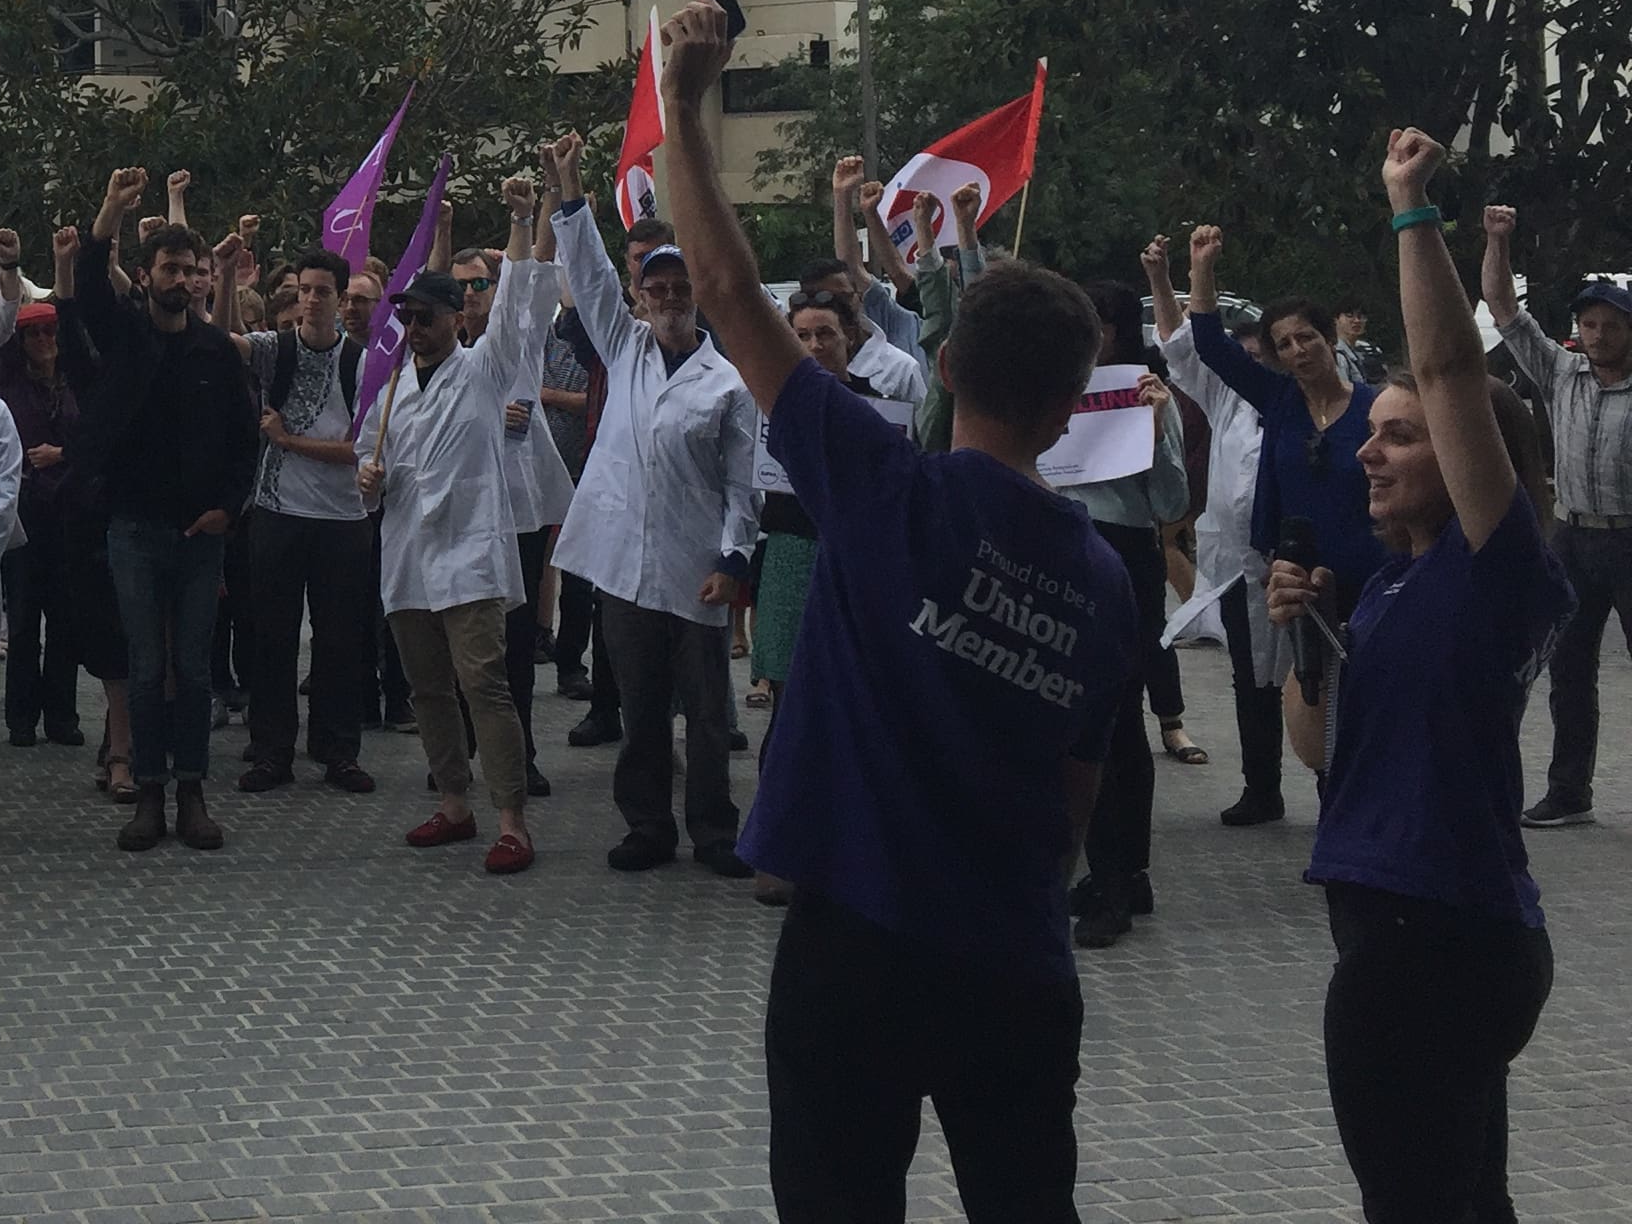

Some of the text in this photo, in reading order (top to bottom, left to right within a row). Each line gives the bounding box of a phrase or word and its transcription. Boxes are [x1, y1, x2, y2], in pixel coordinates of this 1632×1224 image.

[962, 566, 1079, 657] Union
[976, 539, 1097, 616] Proud to be a
[907, 597, 1085, 709] Member
